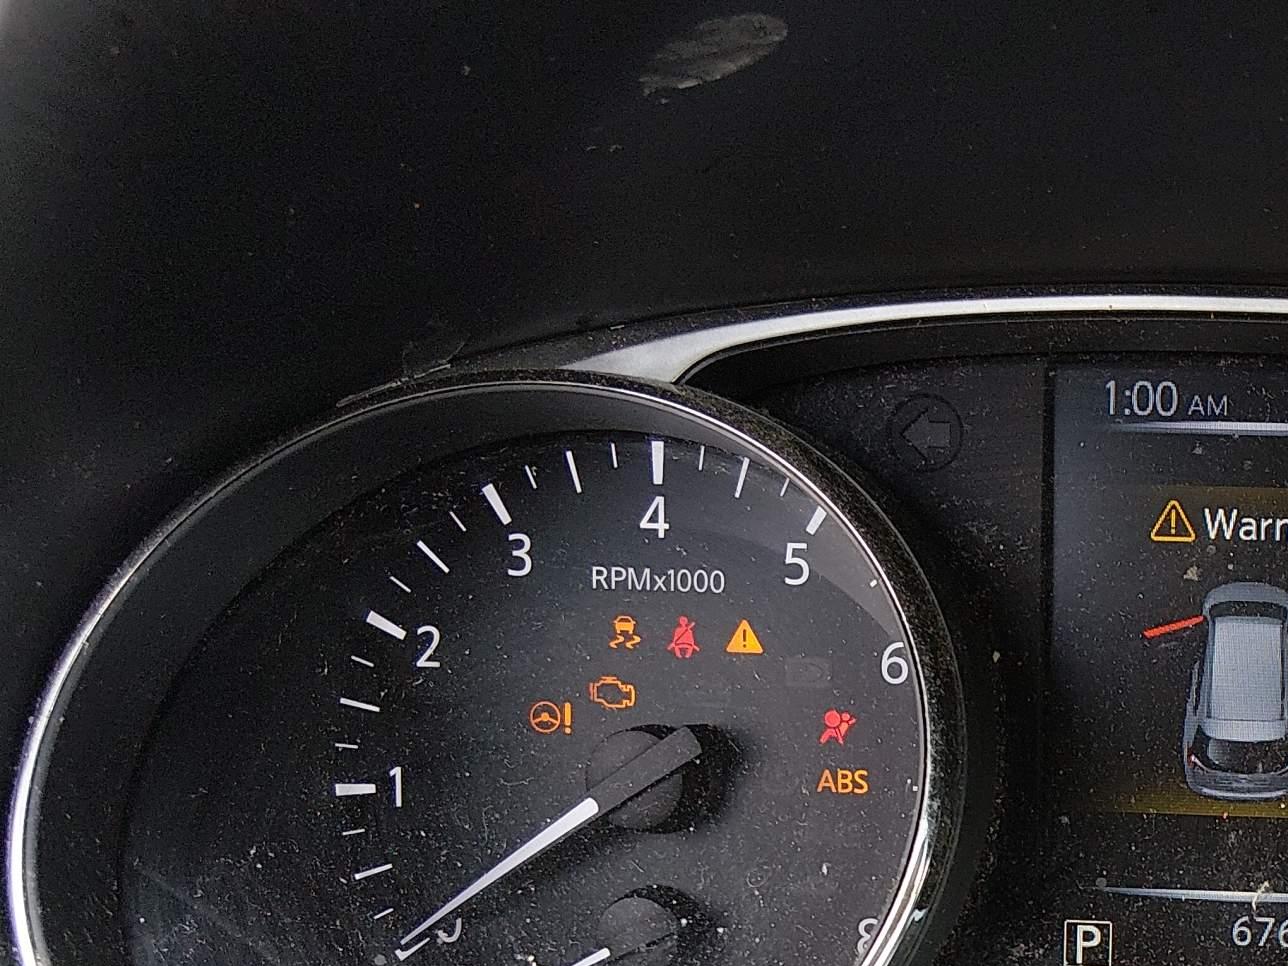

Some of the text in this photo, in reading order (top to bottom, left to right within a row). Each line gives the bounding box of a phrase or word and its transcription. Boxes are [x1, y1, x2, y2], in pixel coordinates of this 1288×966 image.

[1105, 380, 1228, 417] 1:00 AM
[639, 495, 670, 539] 4
[507, 533, 532, 577] 3
[784, 542, 810, 586] 5
[592, 566, 725, 594] RPMx1000
[416, 625, 441, 668] 2
[881, 641, 908, 685] 6
[389, 766, 402, 808] 1
[817, 768, 869, 794] ABS
[1075, 925, 1102, 964] P
